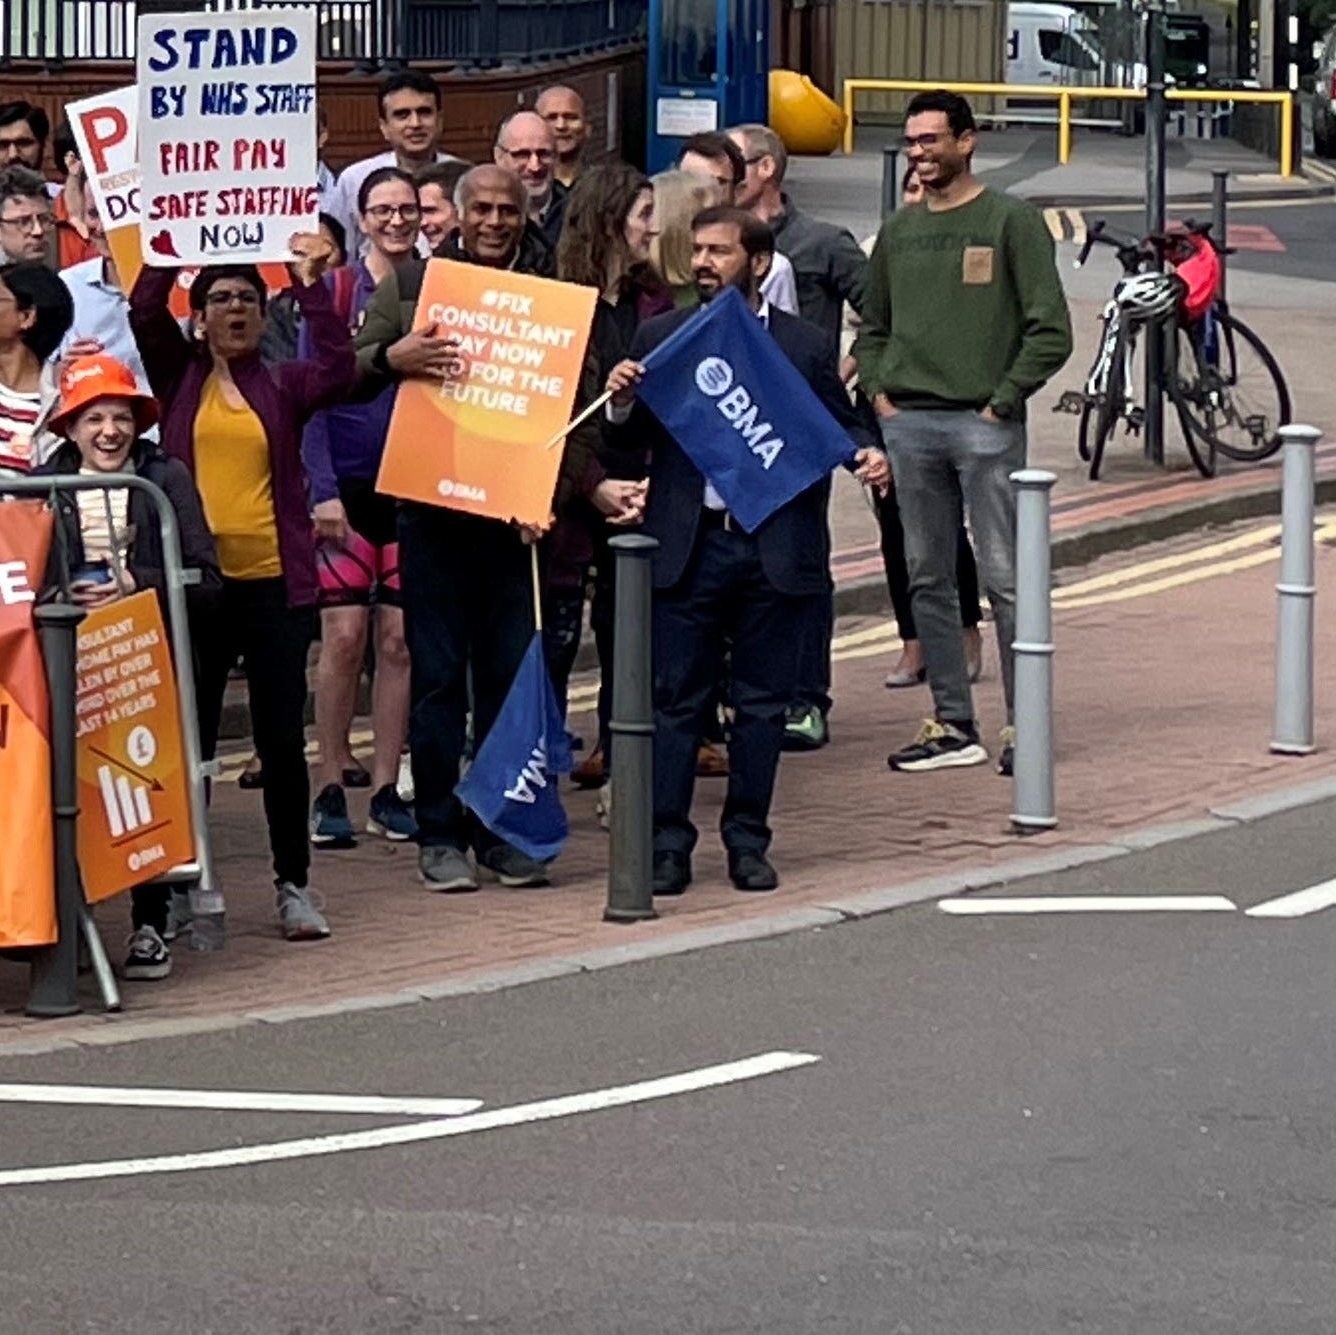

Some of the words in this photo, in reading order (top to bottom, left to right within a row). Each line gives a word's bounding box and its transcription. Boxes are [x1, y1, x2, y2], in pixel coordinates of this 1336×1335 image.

[148, 27, 298, 72] STAND
[150, 84, 187, 119] BY
[199, 81, 248, 115] NHS
[254, 82, 316, 114] STAFF
[160, 139, 220, 175] FAIR
[233, 138, 288, 171] PAY
[148, 190, 207, 220] SAFE
[215, 186, 319, 217] STAFFING
[199, 221, 265, 252] NOW
[481, 290, 534, 317] #FIX
[428, 303, 577, 349] CONSULTANT
[491, 340, 546, 368] NOW
[470, 361, 516, 387] FOR
[519, 371, 564, 398] THE
[439, 380, 529, 416] FUTURE
[716, 384, 786, 471] BMA
[455, 483, 486, 503] BMA
[120, 652, 153, 677] OVER
[138, 668, 162, 690] THE
[120, 691, 157, 719] YEARS
